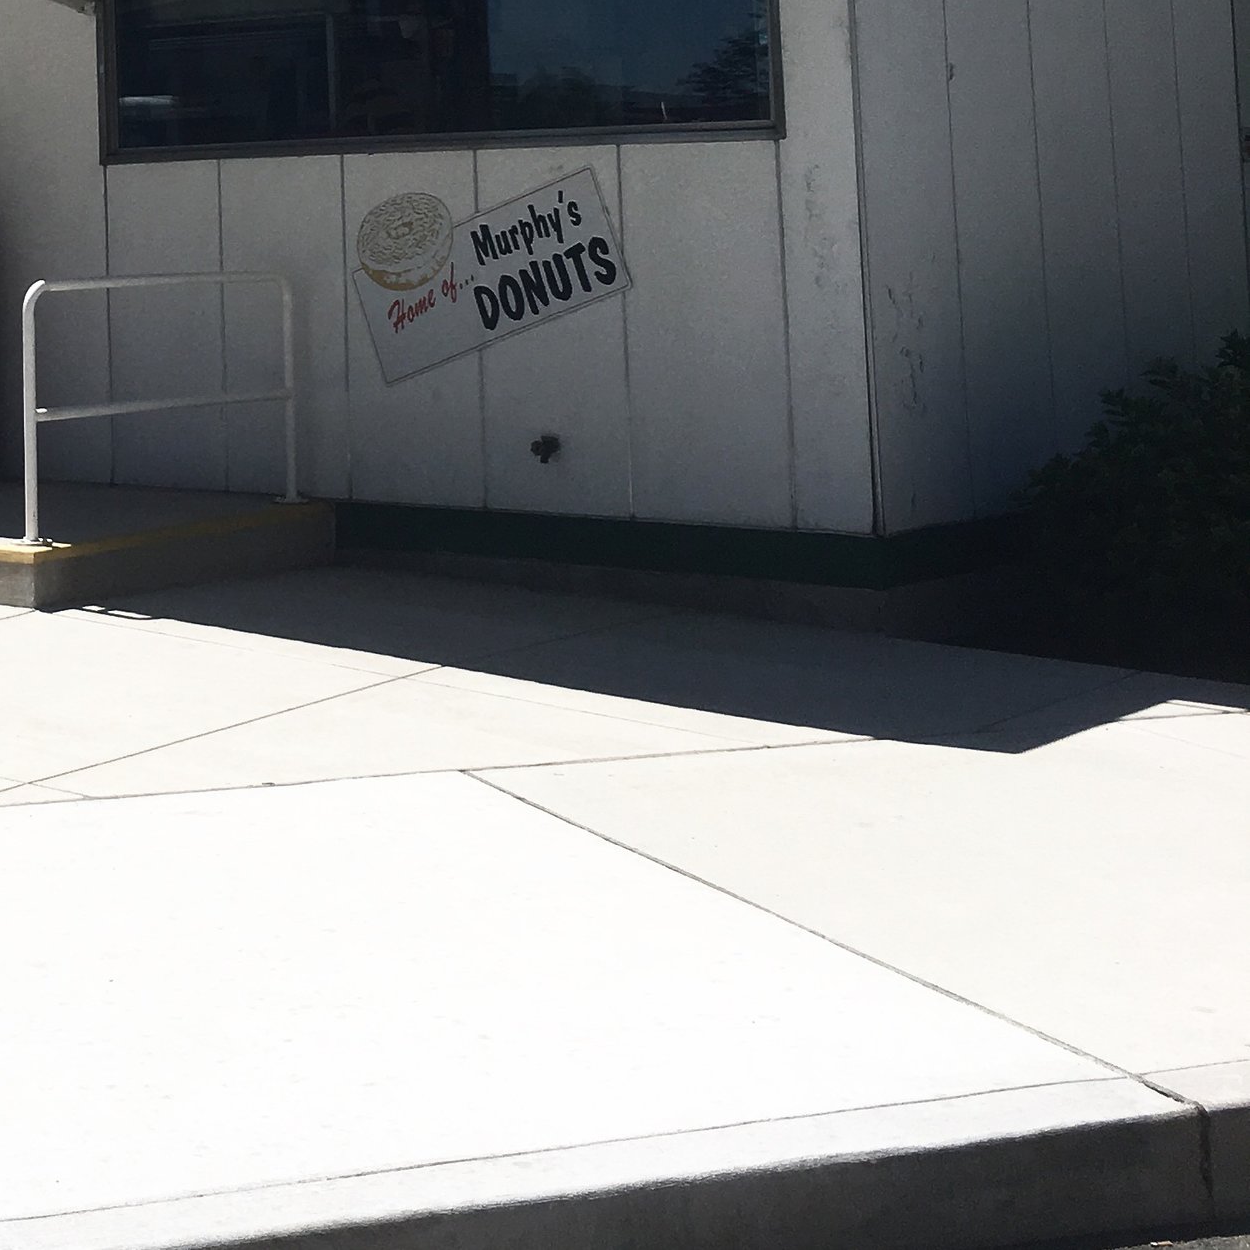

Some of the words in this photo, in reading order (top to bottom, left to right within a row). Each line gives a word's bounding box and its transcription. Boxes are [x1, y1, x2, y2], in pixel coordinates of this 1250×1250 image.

[470, 190, 582, 266] Murphy's
[388, 290, 436, 333] Home
[473, 236, 617, 330] DONUTS
